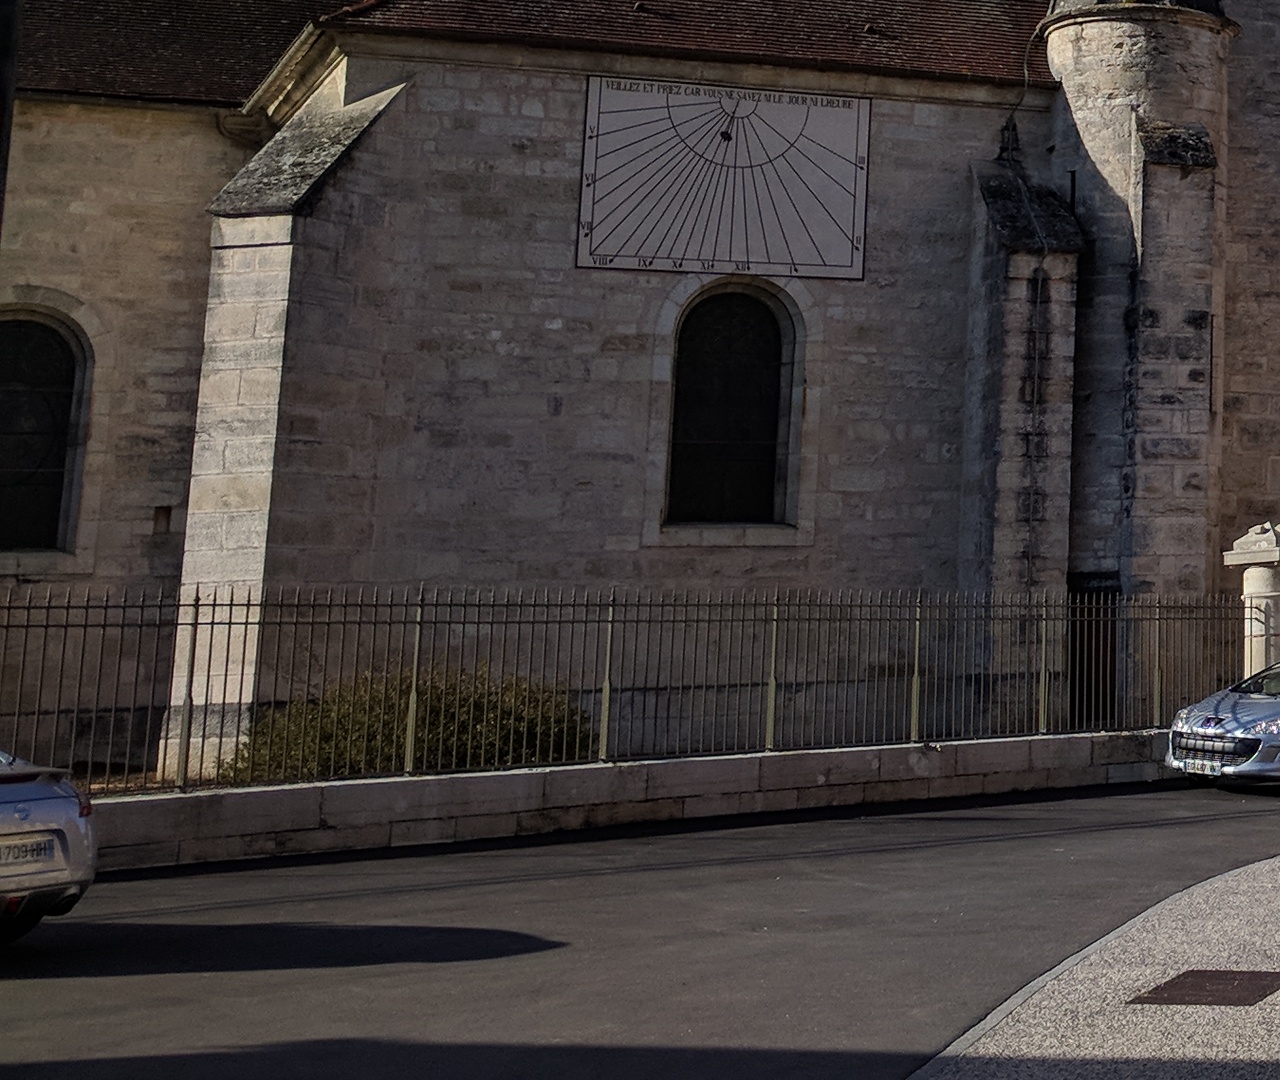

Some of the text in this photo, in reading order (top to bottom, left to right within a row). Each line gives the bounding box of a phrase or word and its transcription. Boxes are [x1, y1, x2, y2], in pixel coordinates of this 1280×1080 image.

[605, 80, 641, 93] VEILLEZ
[643, 83, 655, 94] ET
[684, 86, 701, 97] CAR
[702, 87, 723, 100] VOUS
[786, 95, 808, 106] JOUR
